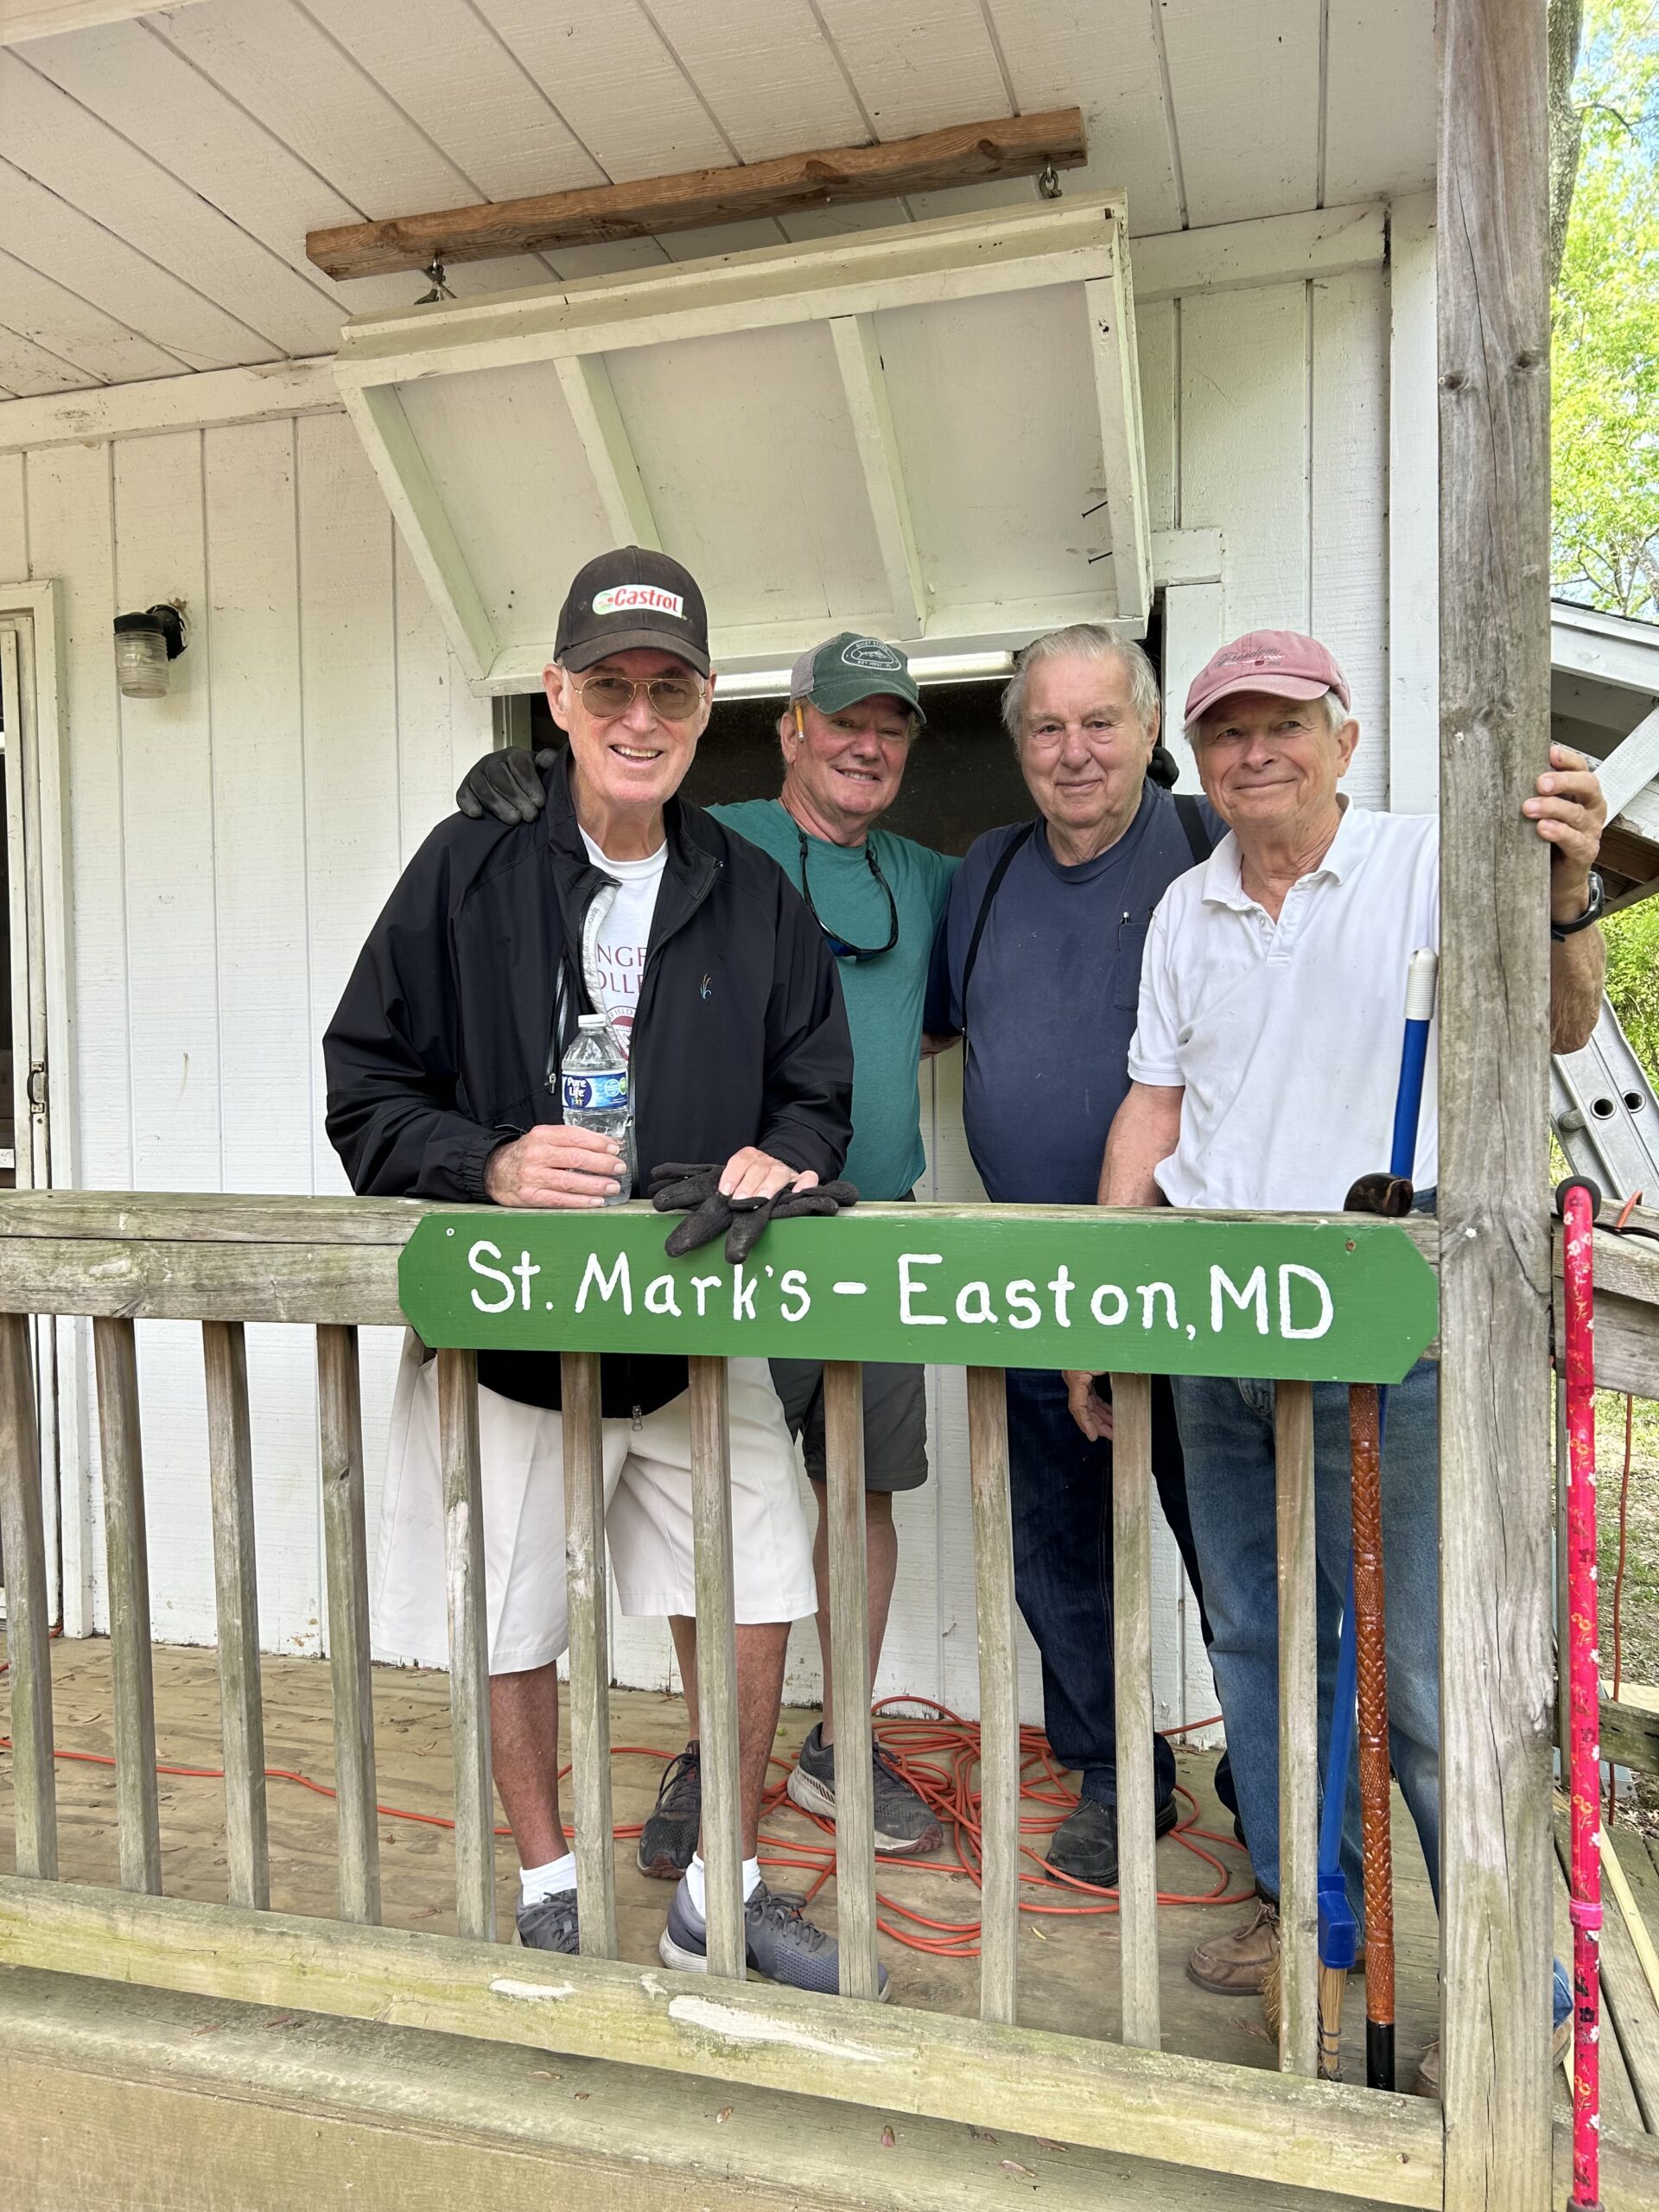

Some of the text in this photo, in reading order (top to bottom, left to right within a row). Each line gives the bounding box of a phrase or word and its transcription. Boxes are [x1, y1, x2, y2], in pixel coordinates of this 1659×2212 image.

[614, 588, 678, 613] Castrol
[567, 1077, 587, 1088] Pure
[569, 1086, 586, 1099] Life
[468, 1241, 555, 1313] St.
[575, 1251, 812, 1323] Mark's
